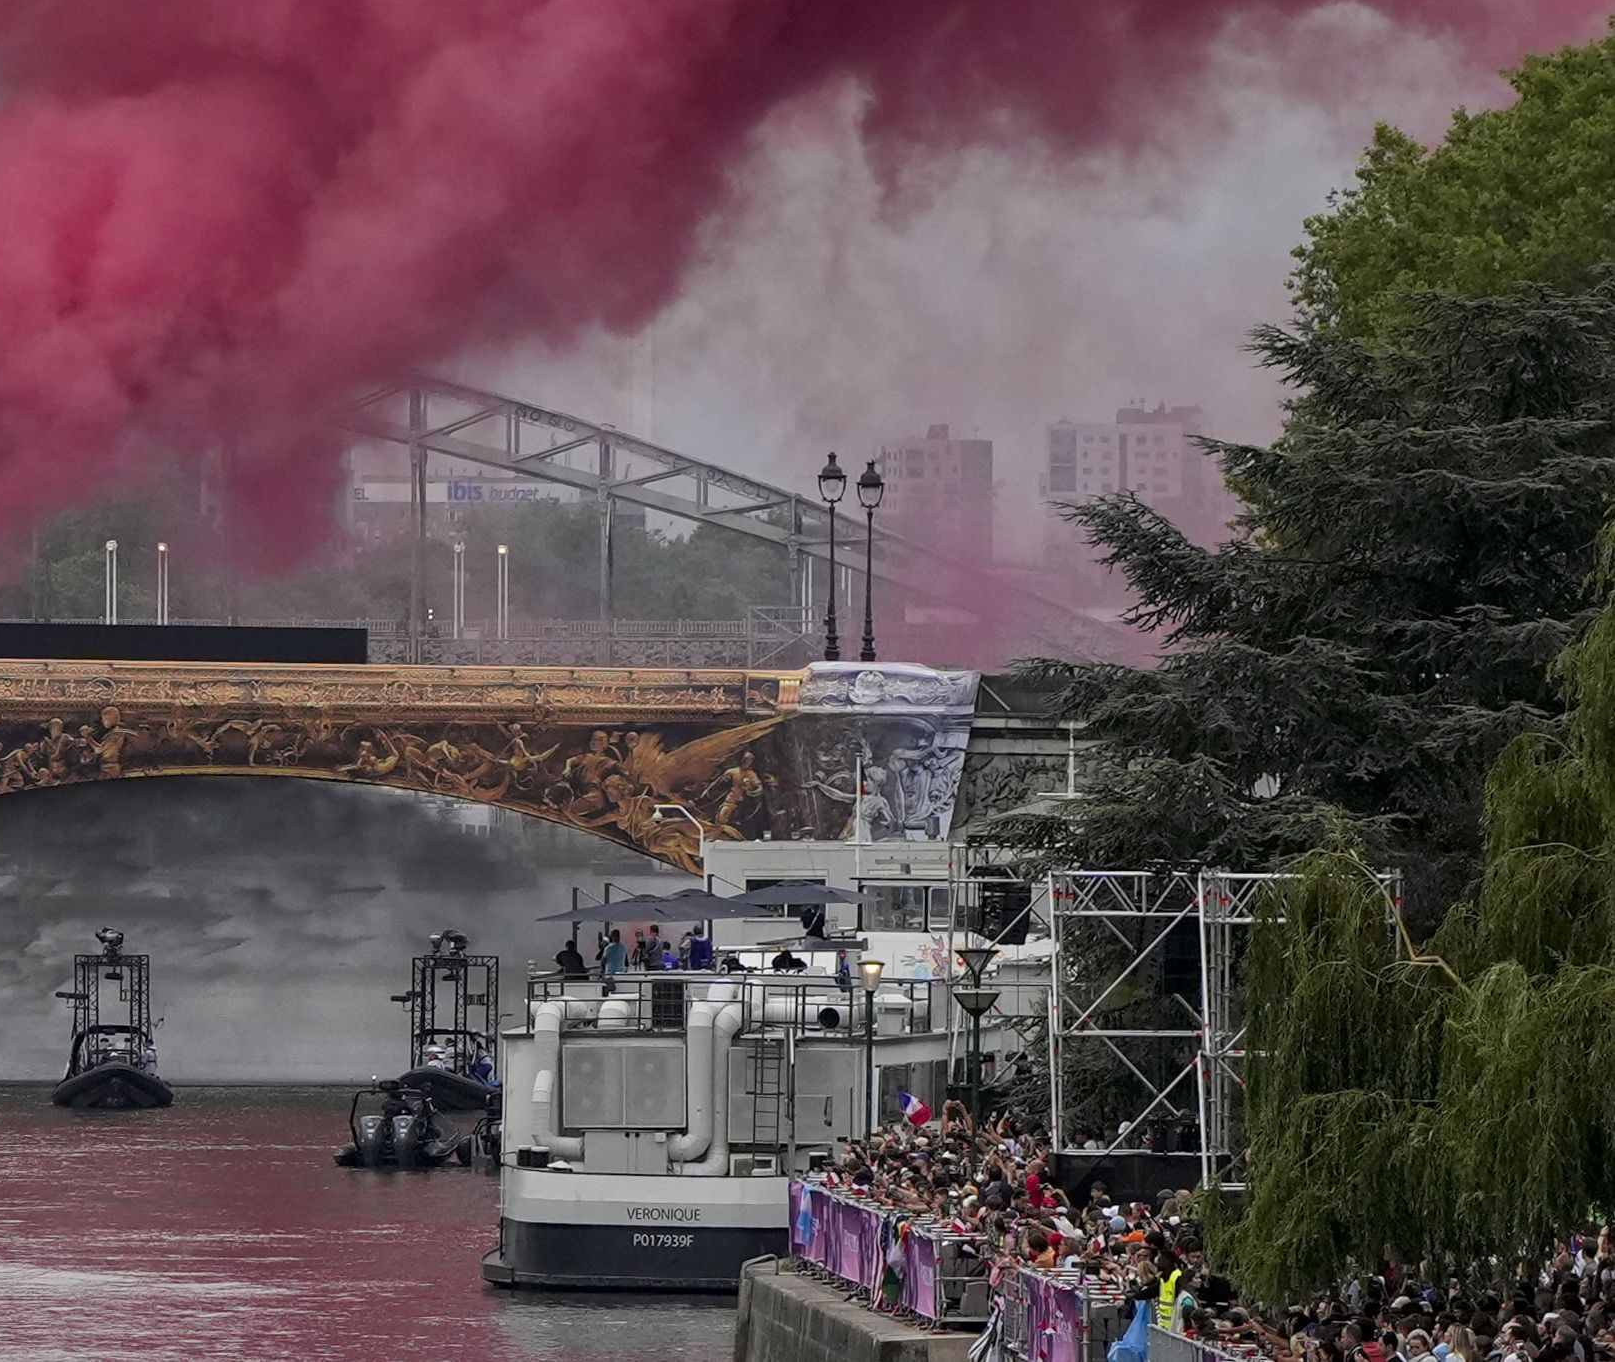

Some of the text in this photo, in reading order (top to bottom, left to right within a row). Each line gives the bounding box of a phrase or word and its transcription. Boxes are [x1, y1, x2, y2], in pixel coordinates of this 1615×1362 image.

[448, 480, 483, 501] ibis
[627, 1207, 701, 1222] VERONIQUE
[633, 1233, 694, 1248] P017939F
